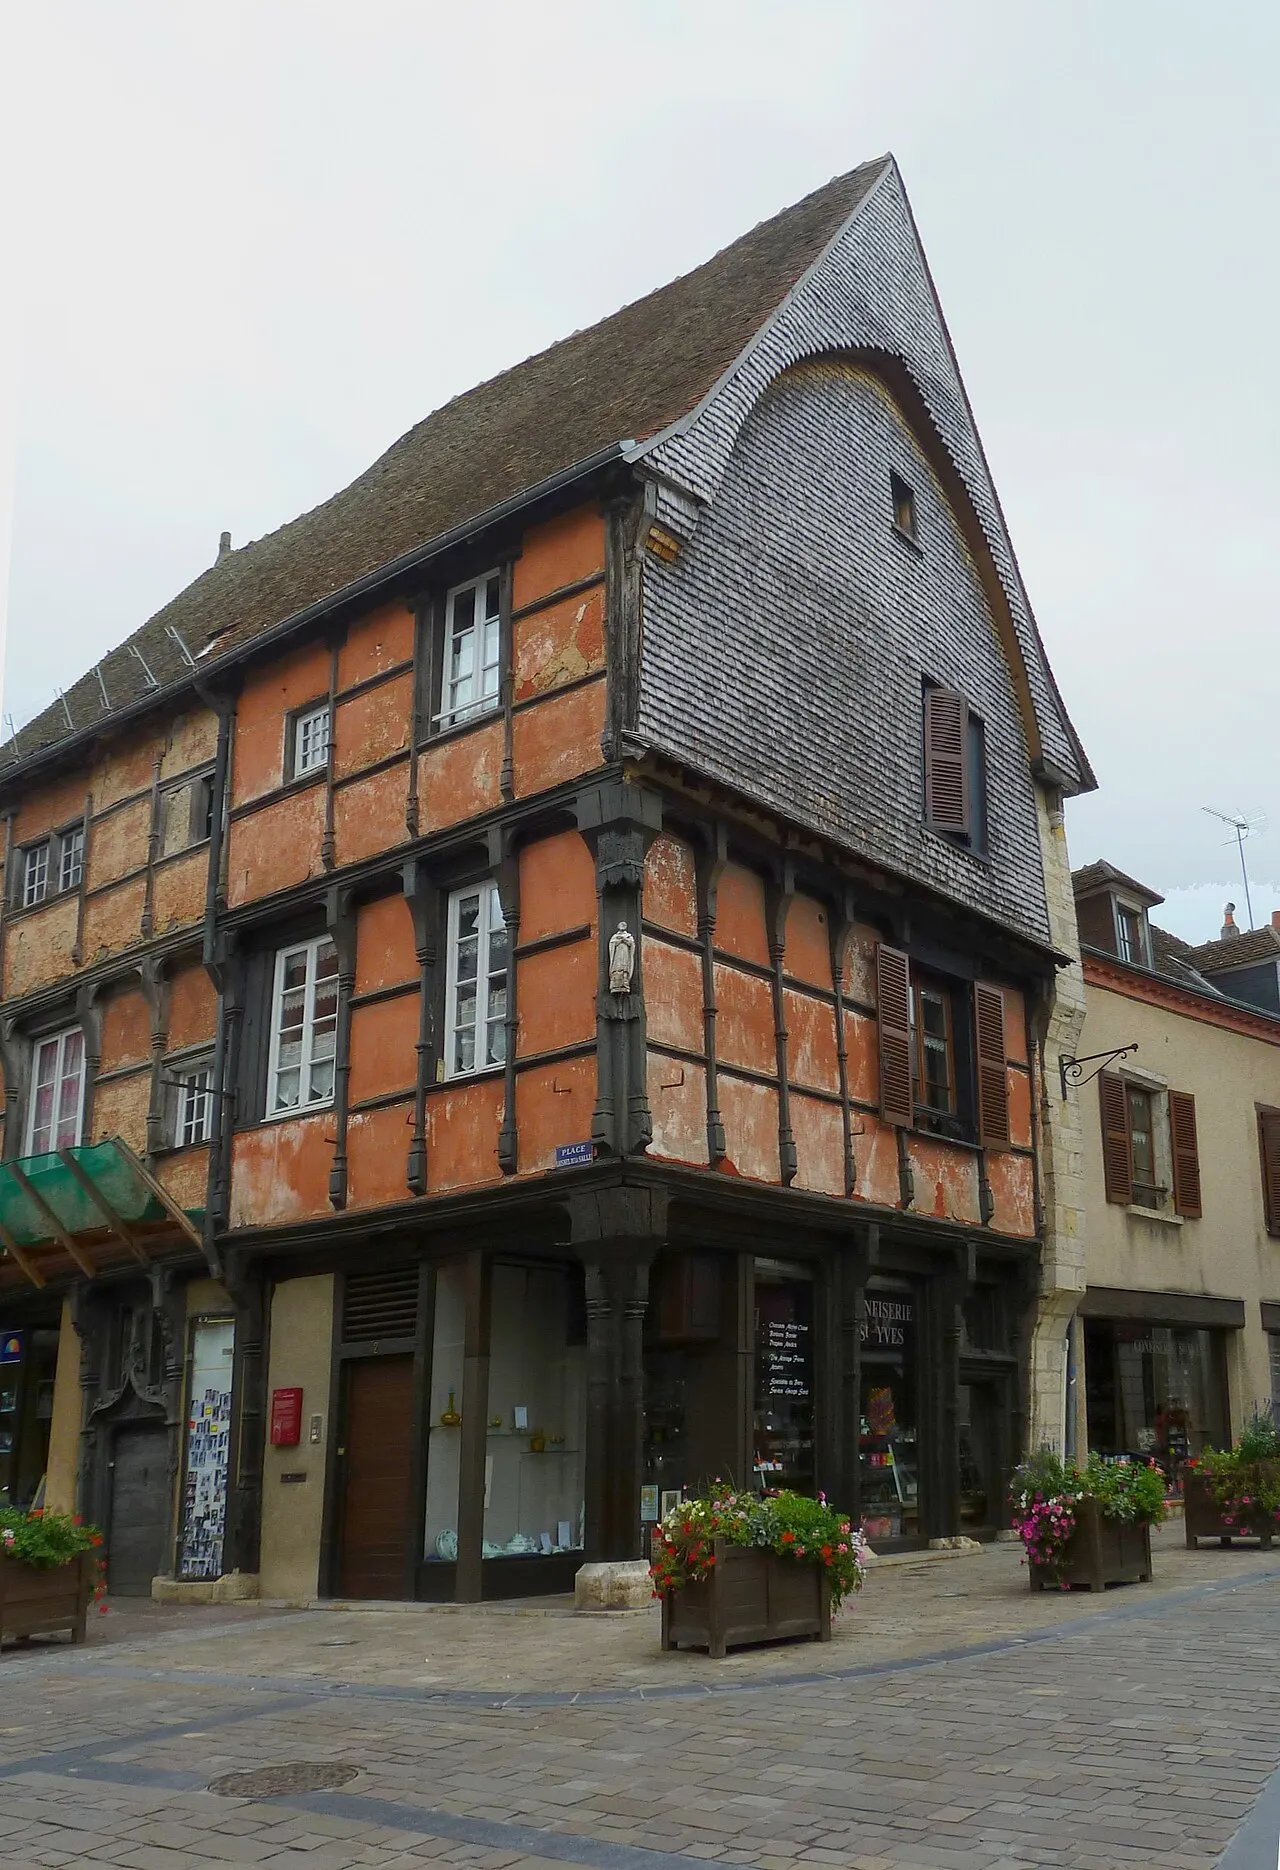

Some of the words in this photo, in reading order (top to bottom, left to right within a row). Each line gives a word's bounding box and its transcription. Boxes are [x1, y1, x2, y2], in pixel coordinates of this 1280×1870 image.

[561, 1145, 586, 1157] PLACE
[863, 1299, 912, 1321] NFISERIE
[876, 1326, 904, 1345] YVES
